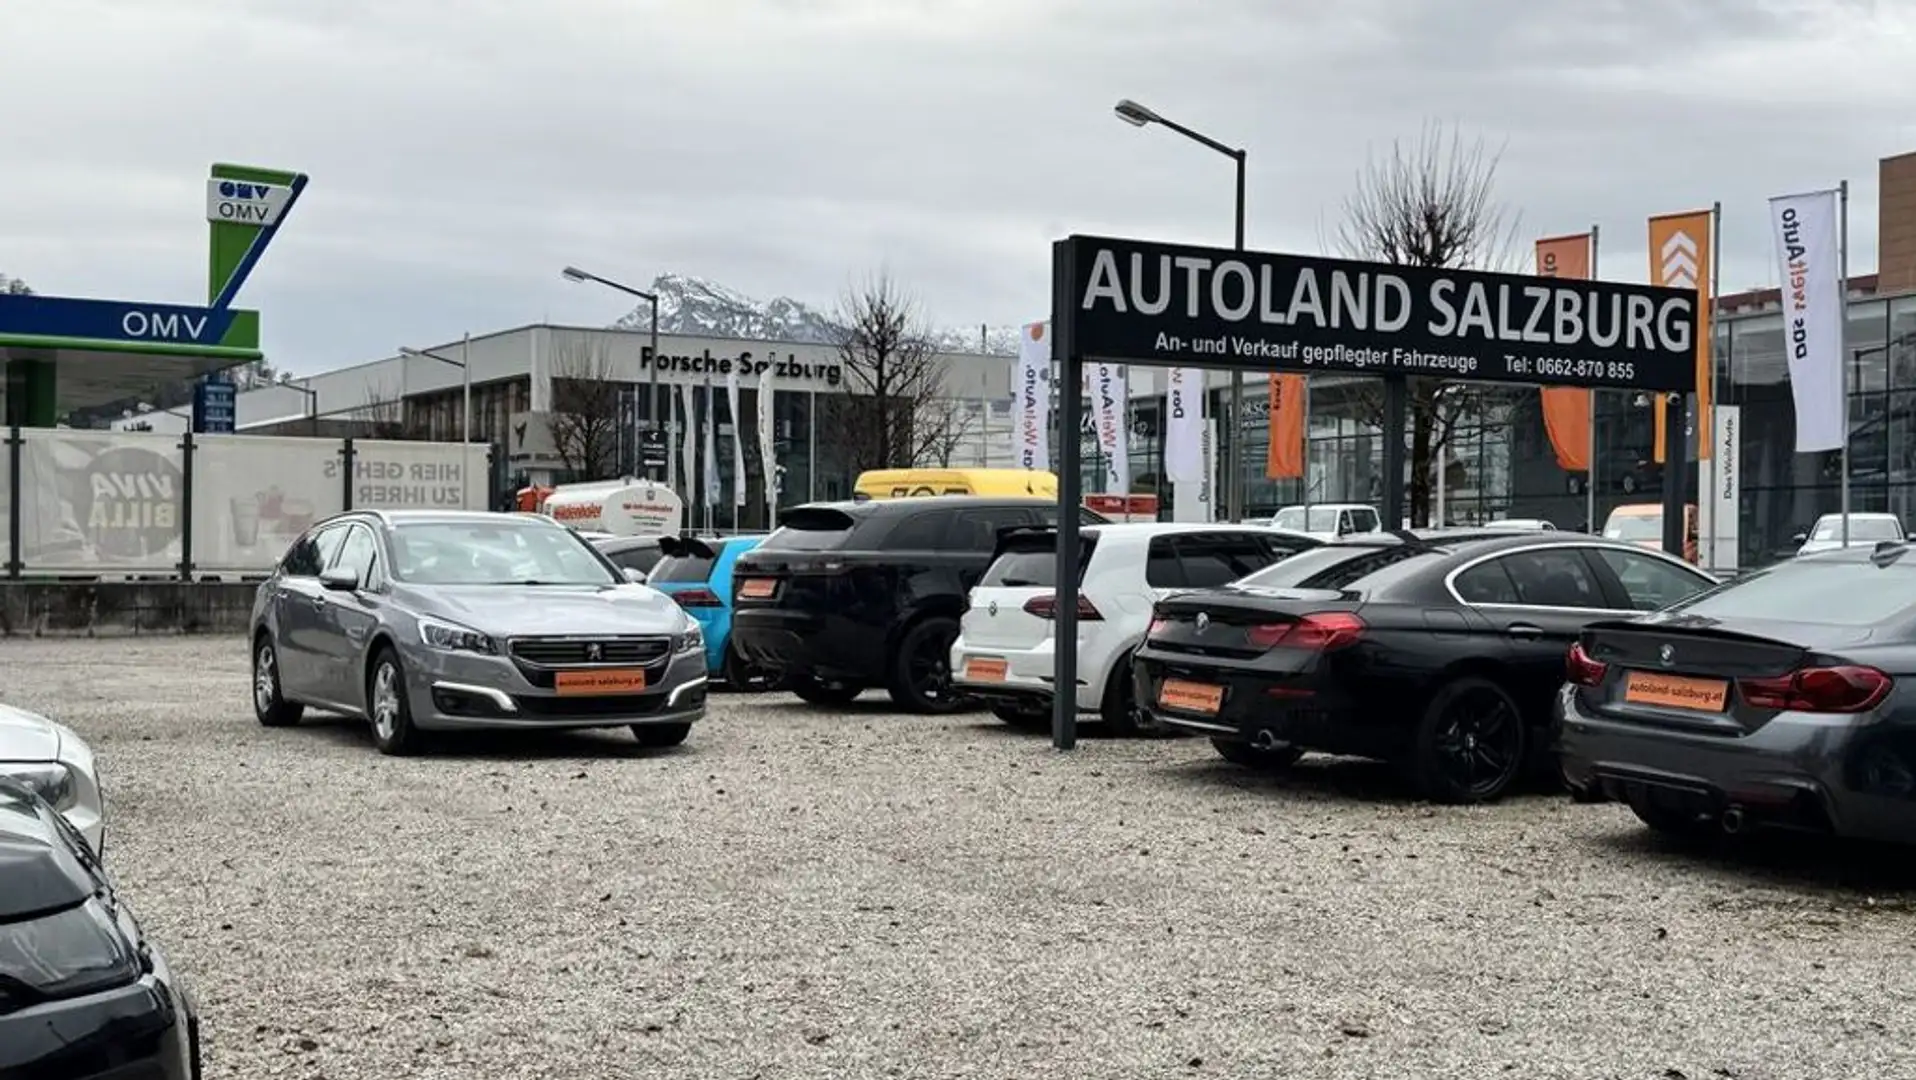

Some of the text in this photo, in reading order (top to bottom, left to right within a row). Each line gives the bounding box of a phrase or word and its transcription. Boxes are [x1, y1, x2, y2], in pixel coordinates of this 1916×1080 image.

[219, 202, 269, 220] OMV
[1082, 250, 1691, 352] AUTOLAND SALZBURG
[123, 311, 208, 339] OMV
[640, 346, 732, 374] Porsche
[1155, 332, 1477, 373] An- und Verkauf gepflegter Fahrzeuge
[1504, 355, 1634, 379] Tel: 0662-870 855
